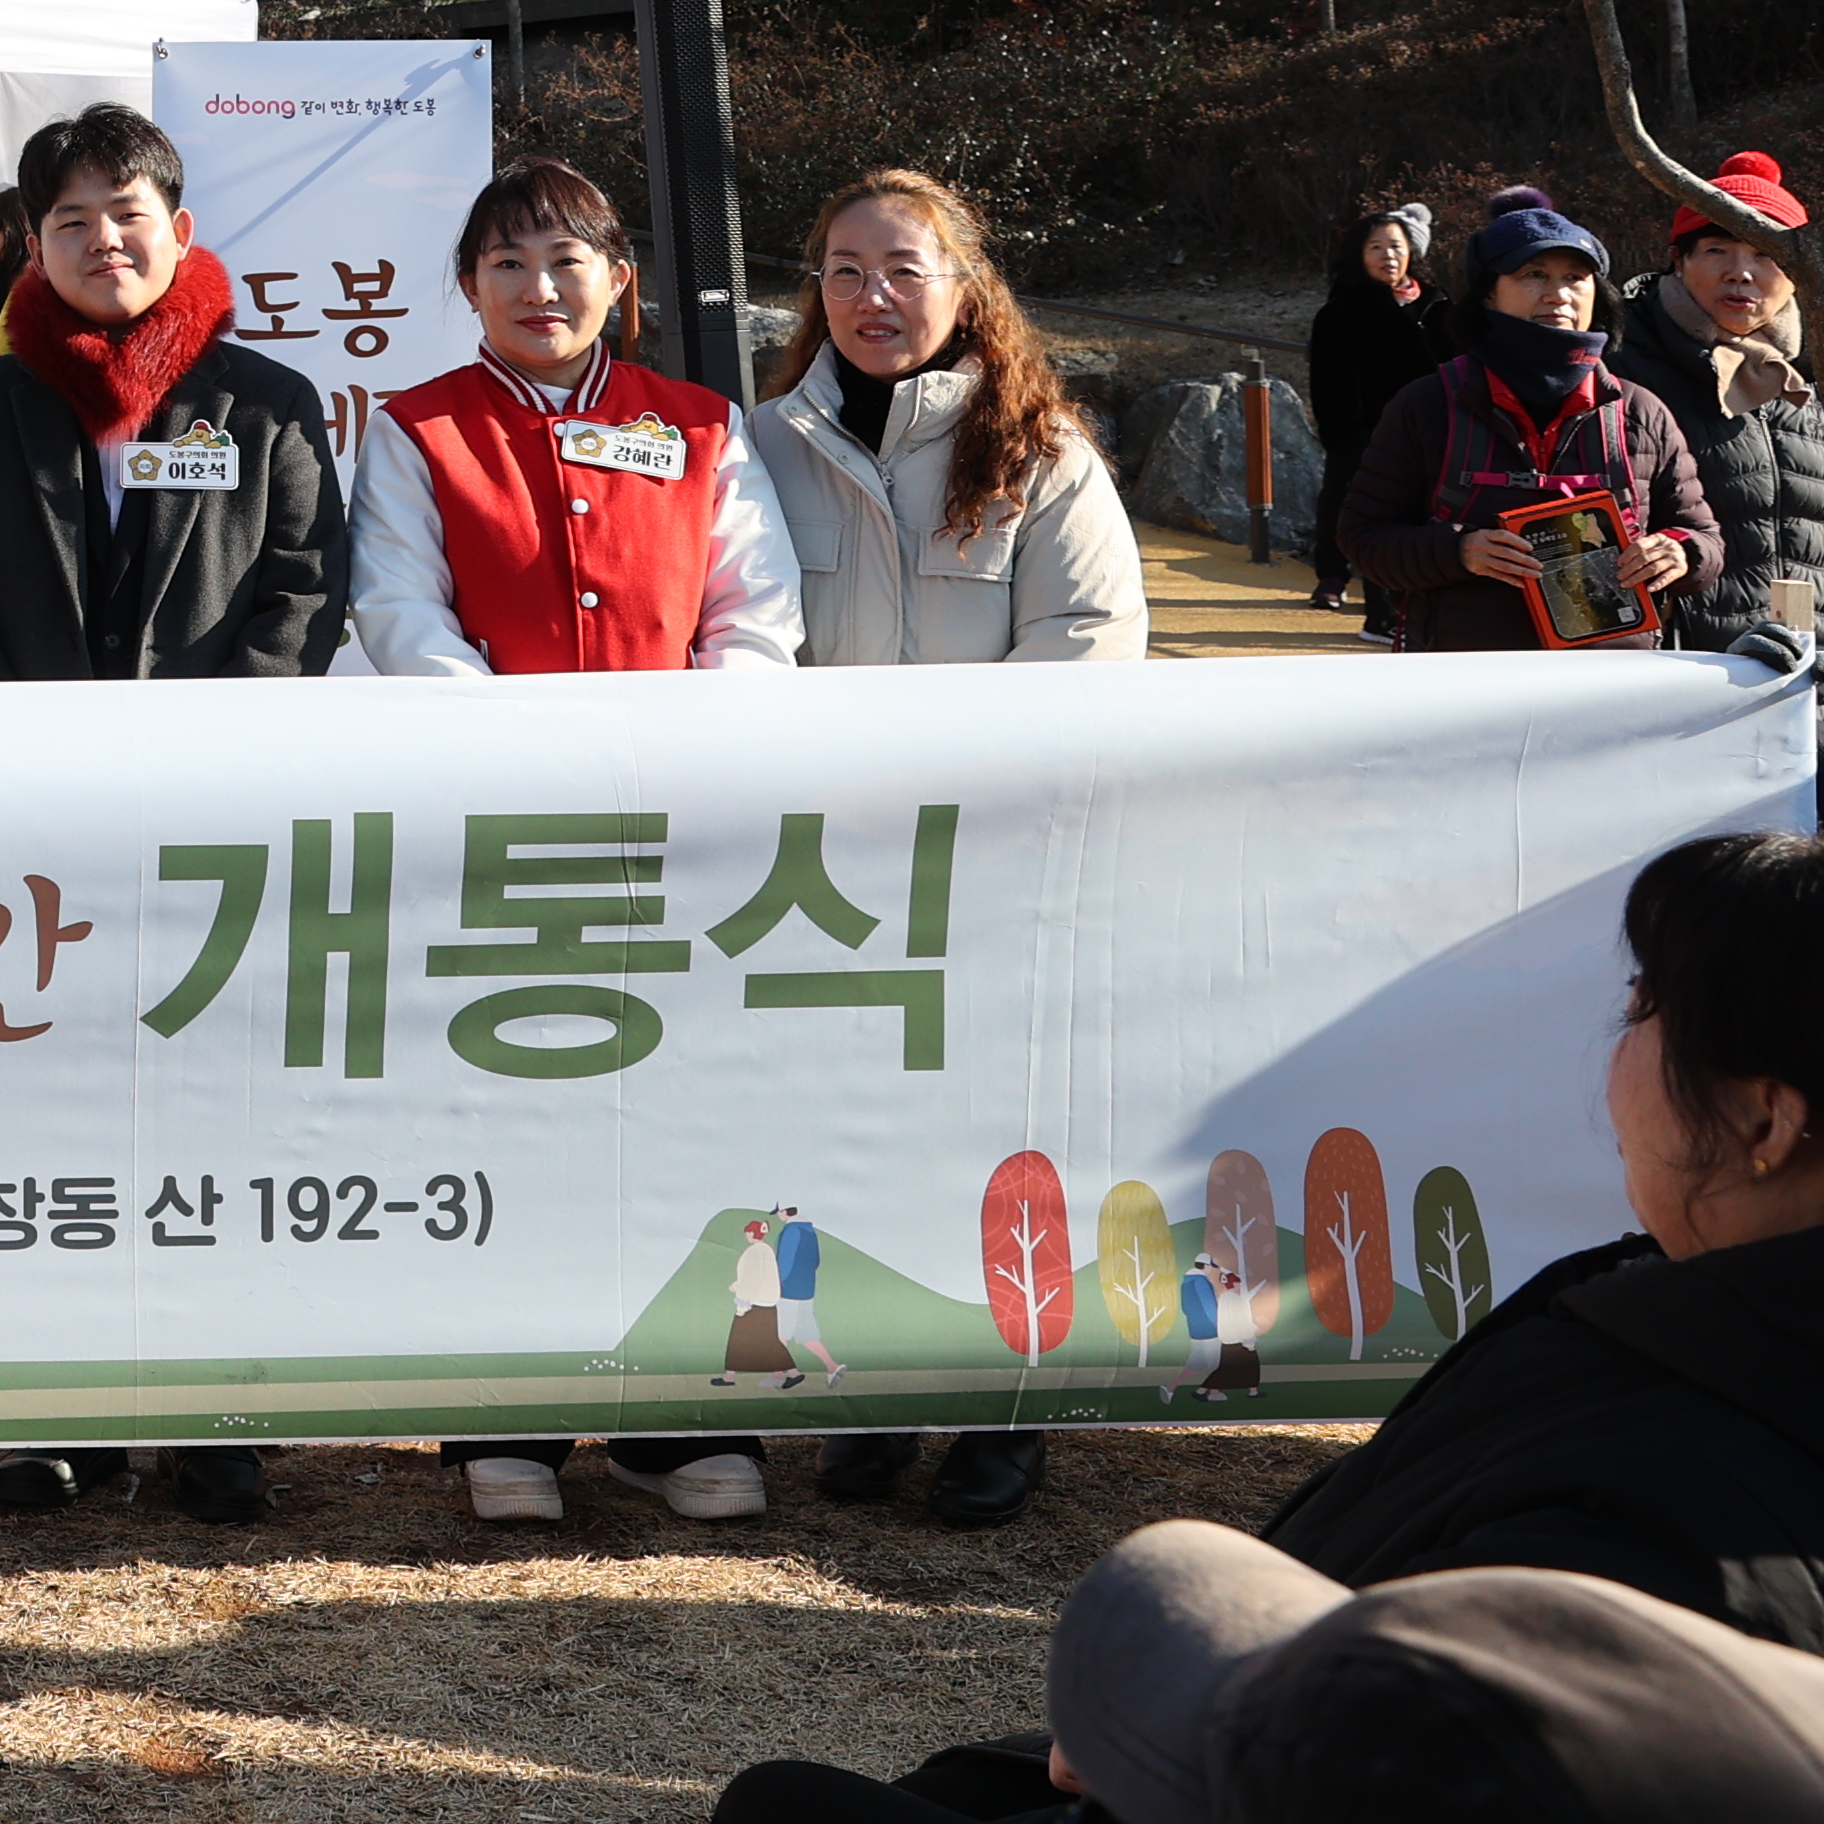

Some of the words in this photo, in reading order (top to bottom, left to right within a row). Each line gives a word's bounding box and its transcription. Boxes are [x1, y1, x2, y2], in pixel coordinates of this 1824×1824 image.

[204, 93, 295, 119] dobong
[301, 101, 325, 115] 같이
[331, 98, 361, 116] 변화,
[365, 98, 408, 116] 행복한
[412, 97, 437, 117] 도봉
[235, 258, 408, 358] 도봉
[169, 451, 209, 459] 도봉구의회
[211, 451, 227, 459] 의원
[612, 445, 673, 470] 강혜란
[168, 462, 226, 480] 이호석
[138, 803, 960, 1079] 개통식
[145, 1175, 223, 1246] 산
[249, 1171, 493, 1246] 192-3)
